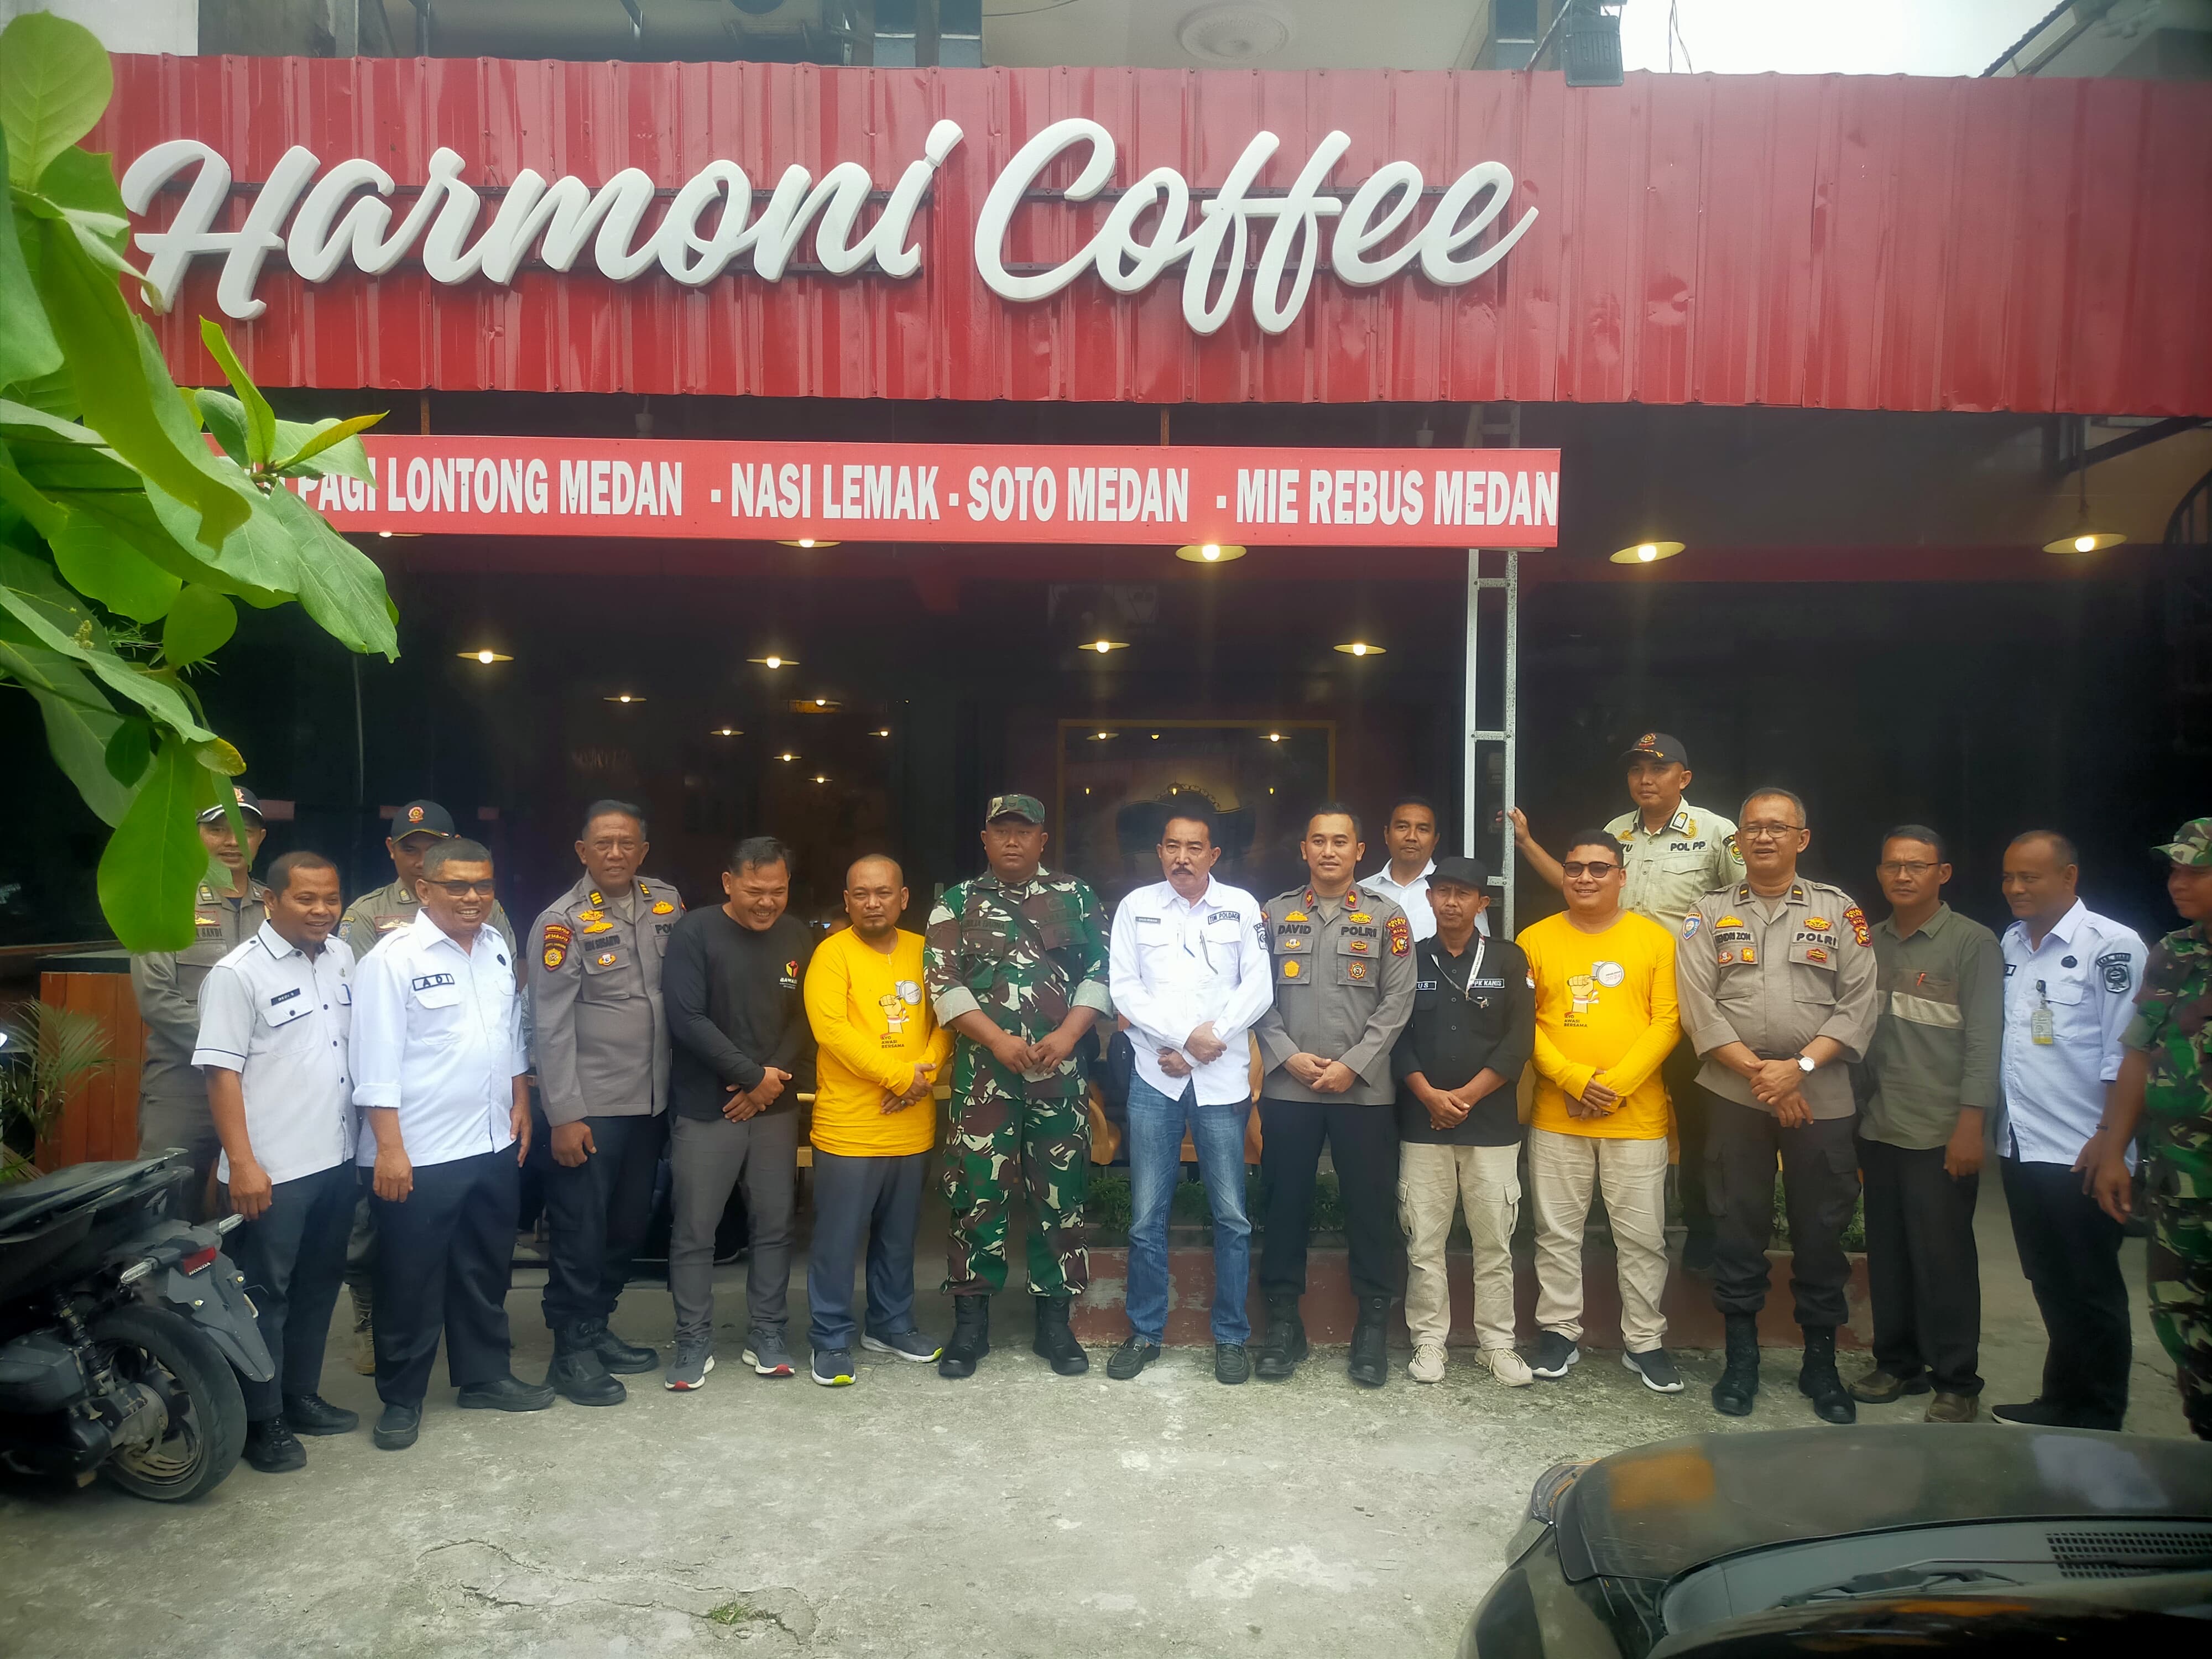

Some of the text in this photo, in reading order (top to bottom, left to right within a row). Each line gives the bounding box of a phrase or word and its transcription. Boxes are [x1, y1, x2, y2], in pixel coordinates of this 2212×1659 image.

[121, 117, 1540, 334] Harmoni Coffee
[298, 457, 376, 512] PAGI
[388, 457, 549, 514] LONTONG
[560, 460, 682, 516] MEDAN
[732, 462, 811, 519] NASI
[822, 464, 940, 520] LEMAK
[967, 466, 1057, 522] SOTO
[1067, 467, 1189, 523] MEDAN
[1236, 468, 1300, 524] MIE
[1309, 469, 1424, 526] REBUS
[1433, 470, 1558, 526] MEDAN
[1671, 841, 1706, 852] POL PP
[1278, 924, 1312, 935] DAVID
[1340, 926, 1377, 937] POLRI
[1796, 932, 1837, 946] POLRI
[422, 974, 450, 988] ADI
[189, 1262, 211, 1276] HONDA
